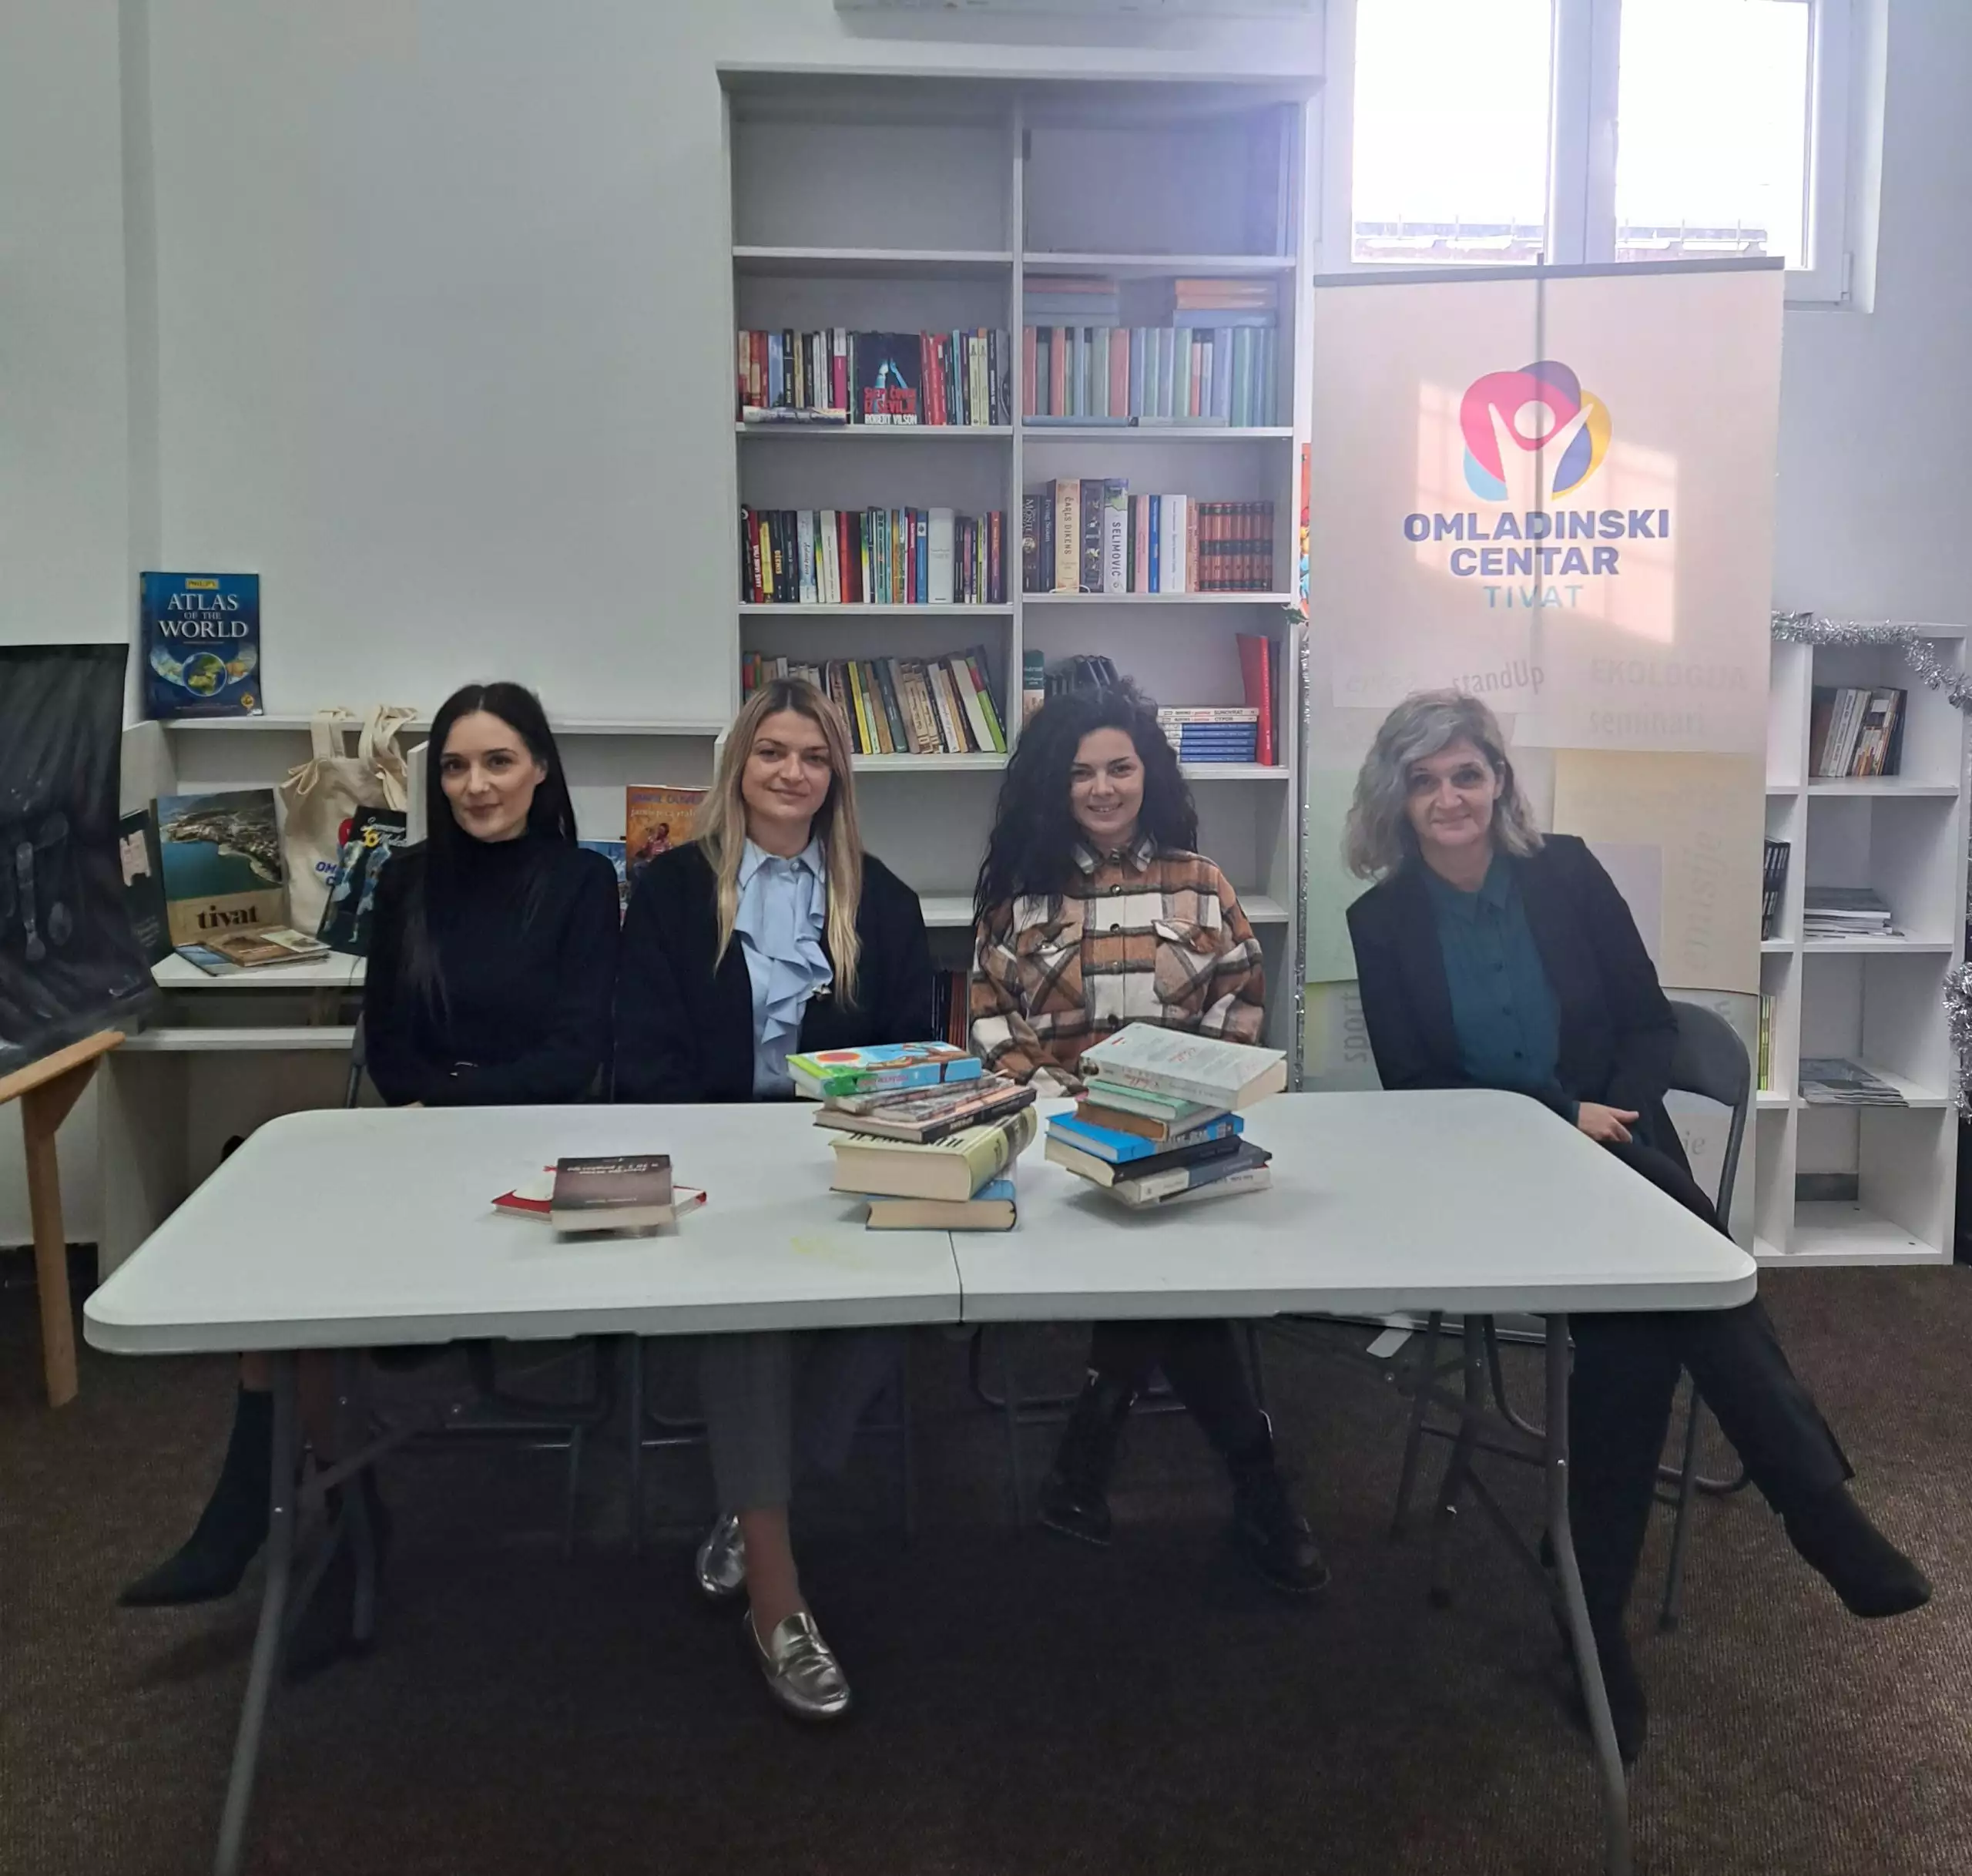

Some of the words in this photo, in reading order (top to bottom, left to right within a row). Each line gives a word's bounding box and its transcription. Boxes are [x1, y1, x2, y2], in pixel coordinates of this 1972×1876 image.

[864, 413, 891, 425] ROBERT
[893, 413, 917, 425] VILSON
[1404, 508, 1669, 541] OMLADINSKI
[1064, 524, 1072, 555] DIKENS
[1450, 545, 1619, 577] CENTAR
[167, 592, 240, 611] ATLAS
[1483, 585, 1584, 609] TIVAT
[183, 611, 198, 620] OF
[202, 611, 222, 620] THE
[158, 620, 250, 638] WORLD
[1453, 659, 1545, 695] standUp
[197, 904, 259, 929] tivat
[1341, 991, 1371, 1063] sport
